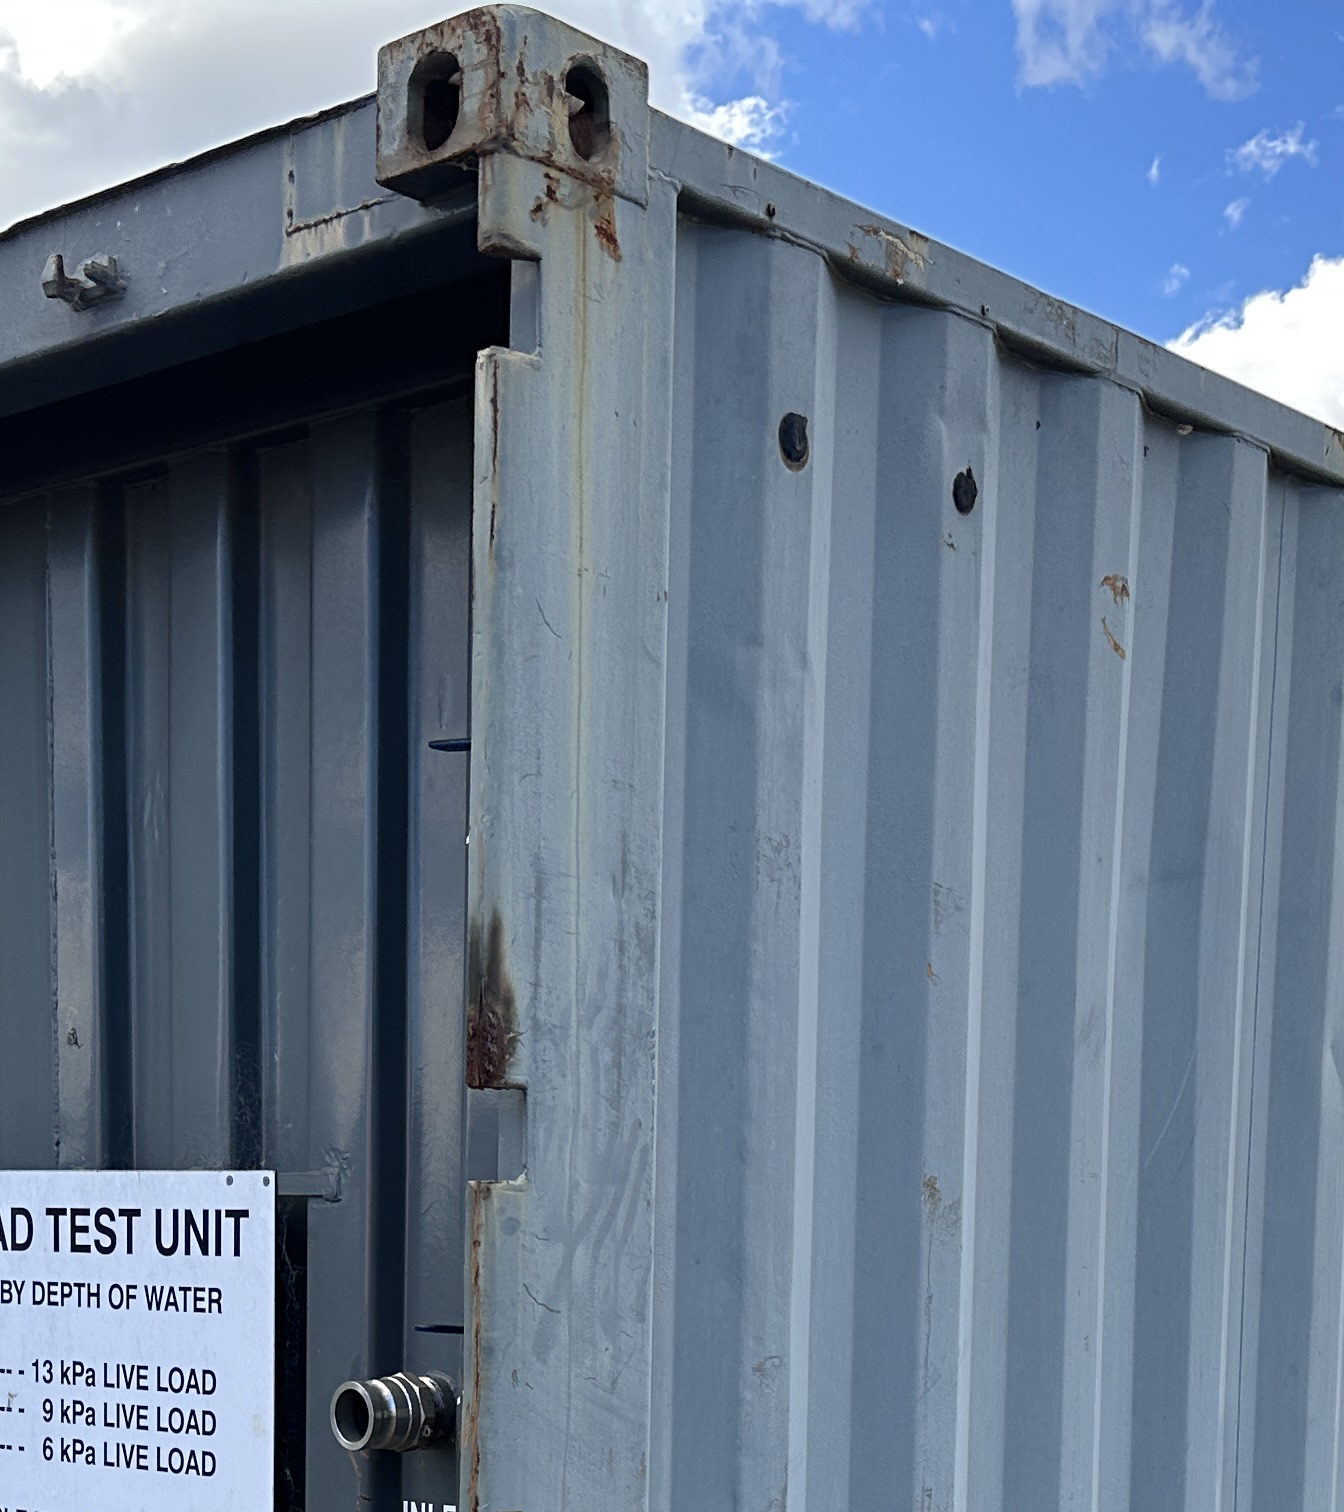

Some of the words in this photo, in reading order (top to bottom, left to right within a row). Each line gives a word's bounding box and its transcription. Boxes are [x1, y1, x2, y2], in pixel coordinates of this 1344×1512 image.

[46, 1207, 141, 1254] TEST
[156, 1209, 249, 1257] UNIT
[1, 1280, 25, 1304] BY
[33, 1281, 100, 1308] DEPTH
[109, 1284, 137, 1309] OF
[144, 1285, 222, 1313] WATER
[32, 1359, 53, 1384] 13
[61, 1360, 95, 1387] kPa
[104, 1363, 148, 1390] LIVE
[157, 1366, 216, 1395] LOAD
[43, 1399, 53, 1422] 9
[61, 1399, 95, 1426] kPa
[104, 1403, 148, 1430] LIVE
[157, 1407, 216, 1436] LOAD
[43, 1437, 53, 1461] 6
[61, 1438, 95, 1465] kPa
[104, 1442, 148, 1470] LIVE
[157, 1447, 216, 1476] LOAD
